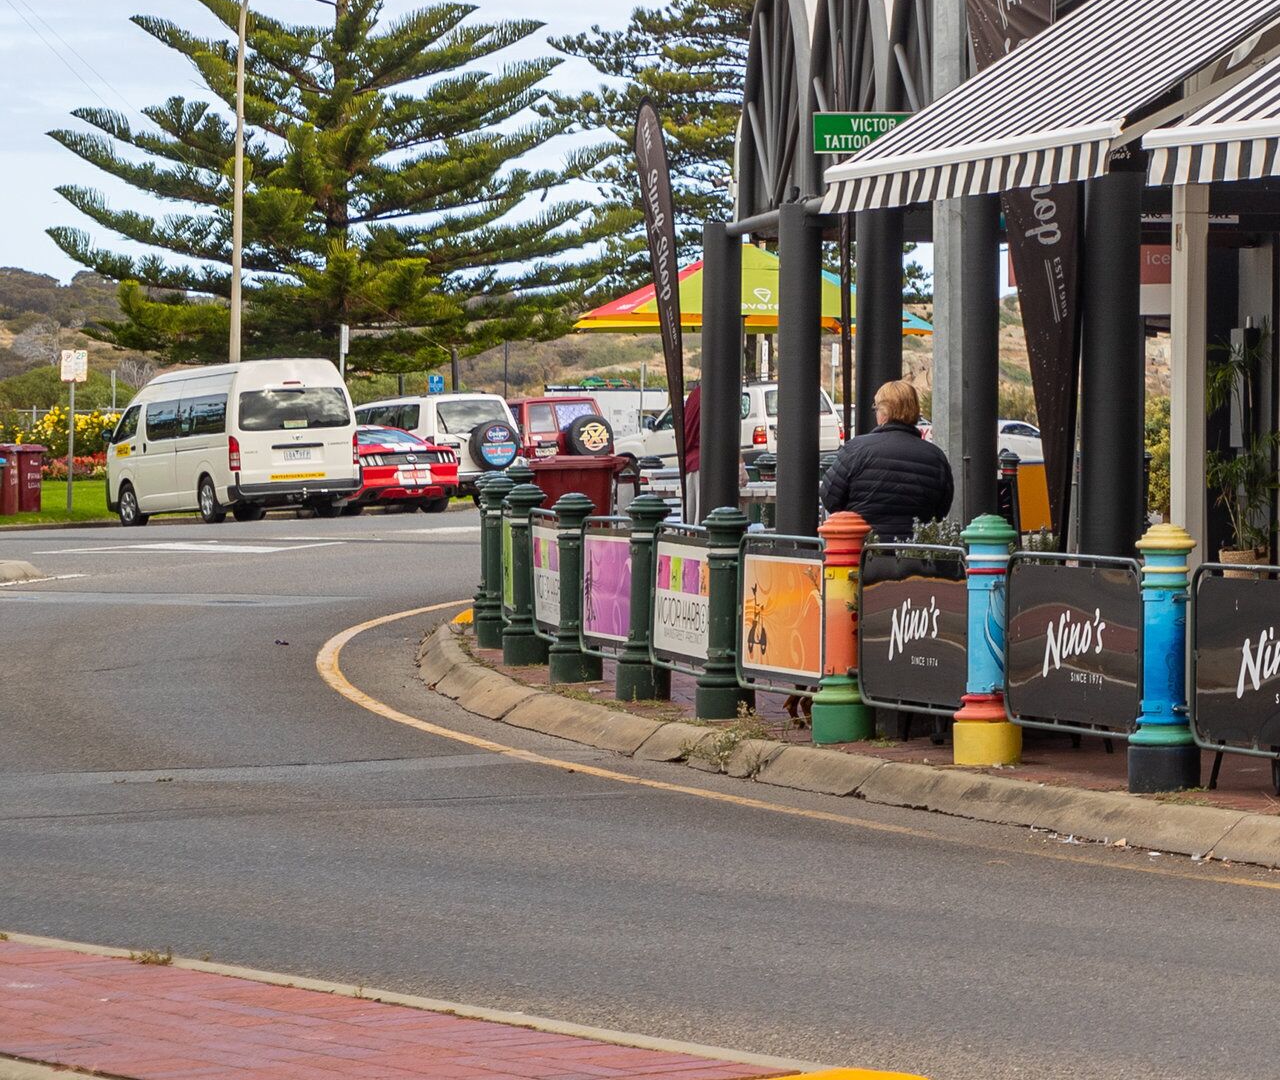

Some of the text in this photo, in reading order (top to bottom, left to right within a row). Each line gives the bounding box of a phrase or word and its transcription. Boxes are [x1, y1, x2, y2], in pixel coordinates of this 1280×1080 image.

[851, 118, 896, 132] VICTOR
[824, 135, 870, 149] TATTOO
[657, 236, 671, 301] Shop
[1053, 257, 1064, 279] EST
[75, 352, 86, 360] 2P
[682, 602, 710, 634] HARBO
[888, 596, 940, 661] Nino's
[1042, 608, 1104, 677] Nino's
[910, 656, 938, 668] SINCE 1974
[1070, 671, 1103, 684] SINCE 1974
